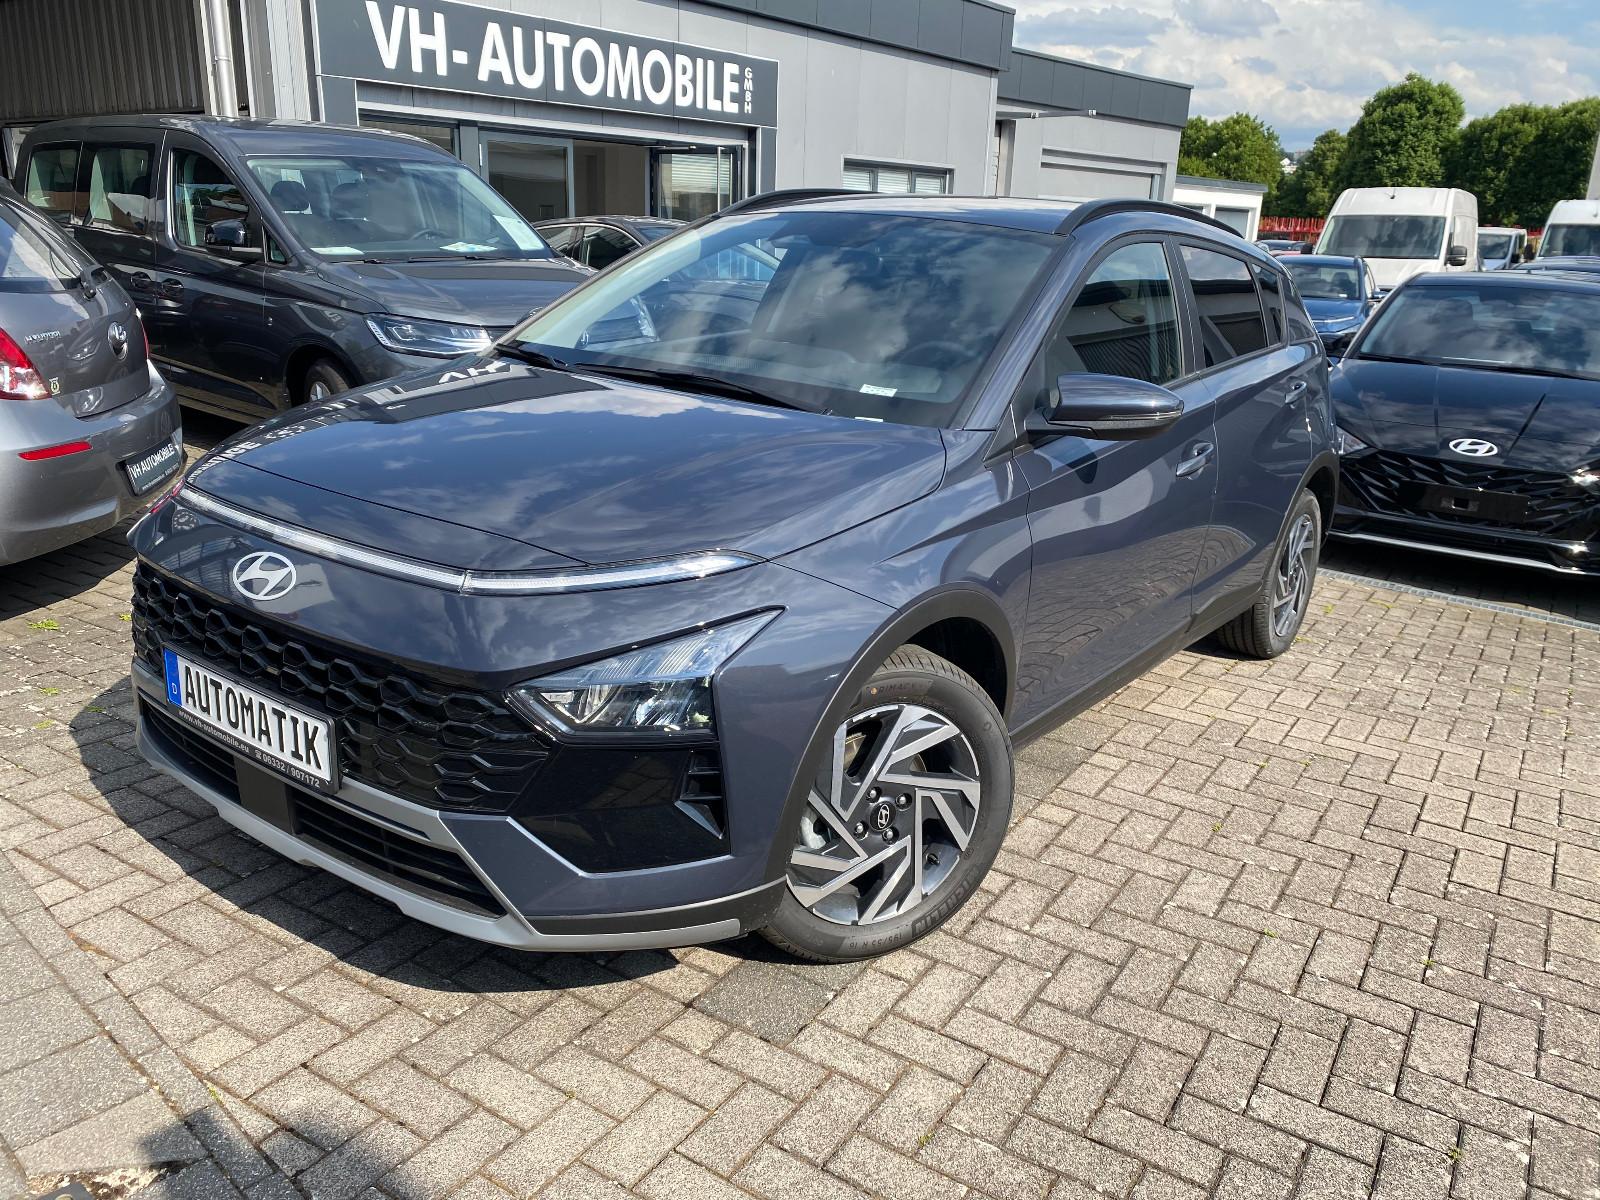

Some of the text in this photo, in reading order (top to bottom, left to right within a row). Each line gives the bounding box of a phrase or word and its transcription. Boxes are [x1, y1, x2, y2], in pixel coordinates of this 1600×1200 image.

[365, 0, 739, 113] VH- AUTOMOBILE
[744, 67, 753, 114] GMBH
[131, 462, 143, 479] VH
[141, 443, 175, 474] AUTOMOBILE
[184, 664, 322, 770] AUTOMATIK
[263, 754, 286, 772] 06332
[290, 767, 321, 788] 907172
